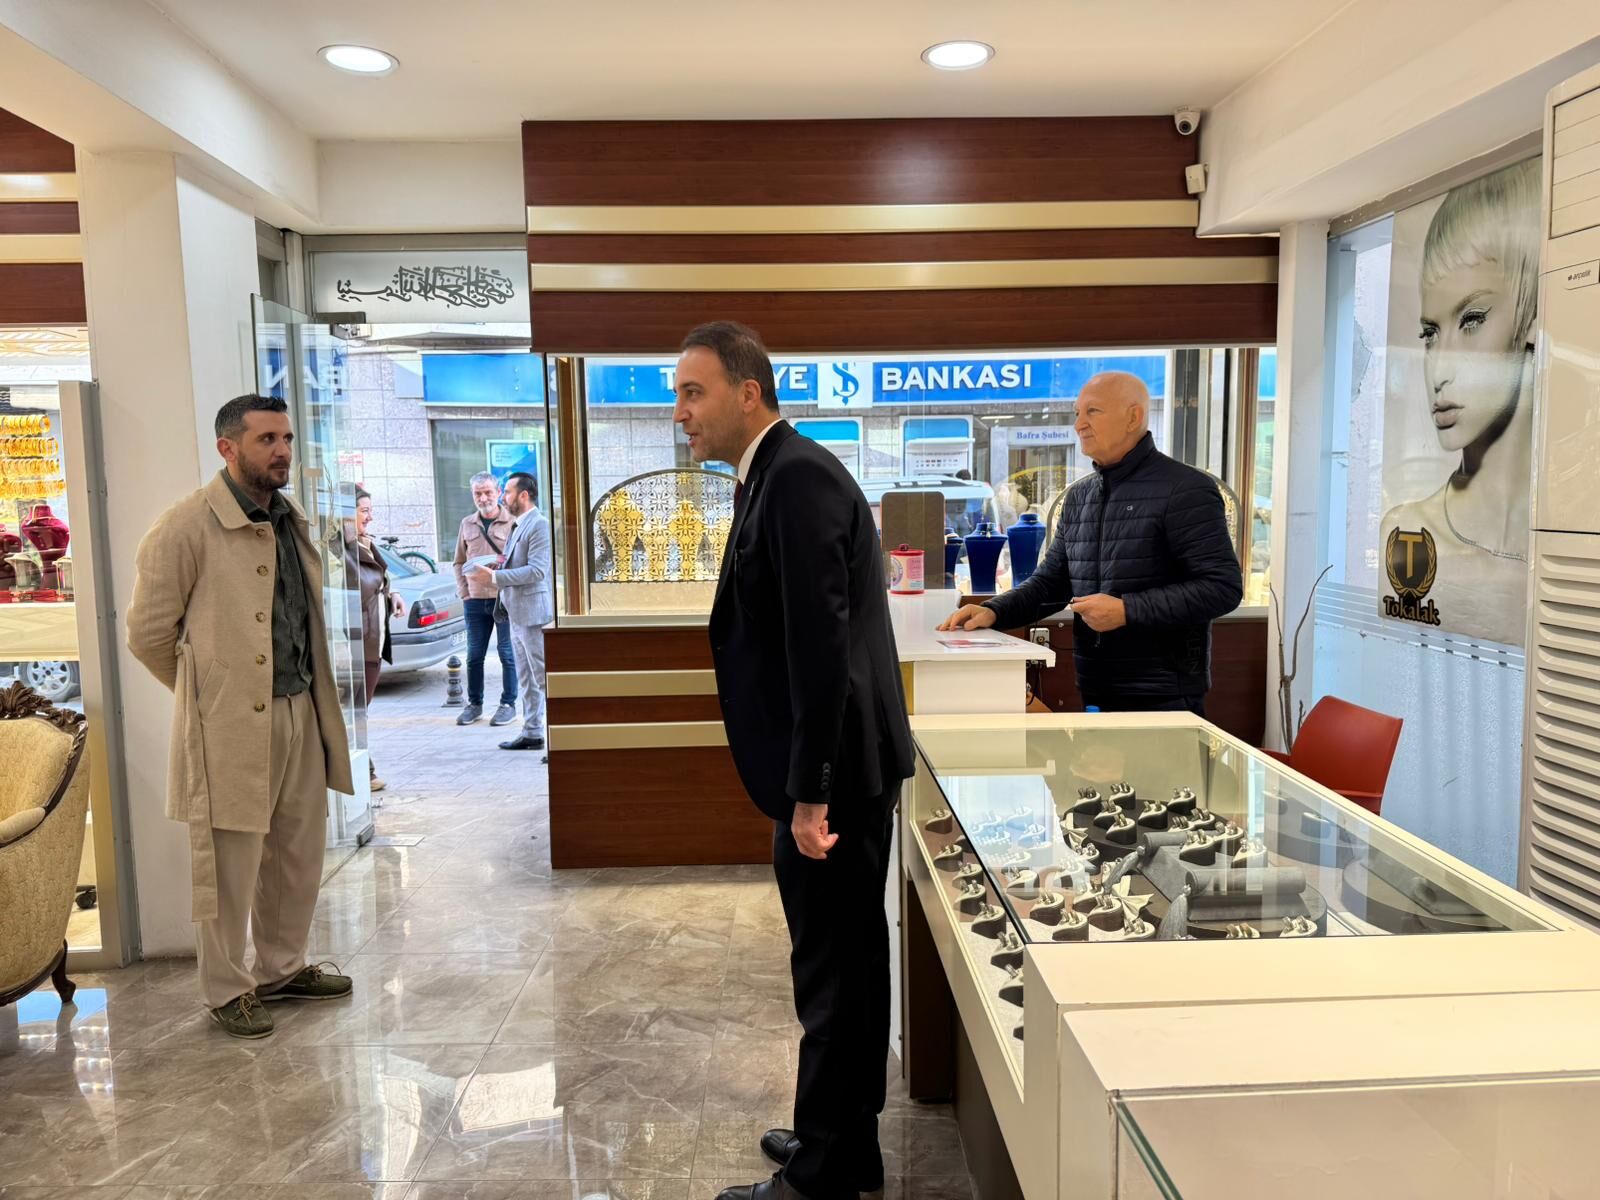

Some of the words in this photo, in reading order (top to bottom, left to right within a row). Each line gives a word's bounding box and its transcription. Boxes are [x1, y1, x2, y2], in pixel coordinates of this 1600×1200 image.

[881, 363, 1032, 392] BANKASI
[1016, 431, 1040, 440] Bafra
[1041, 430, 1069, 440] Şubesi
[1383, 595, 1440, 626] Tokalak
